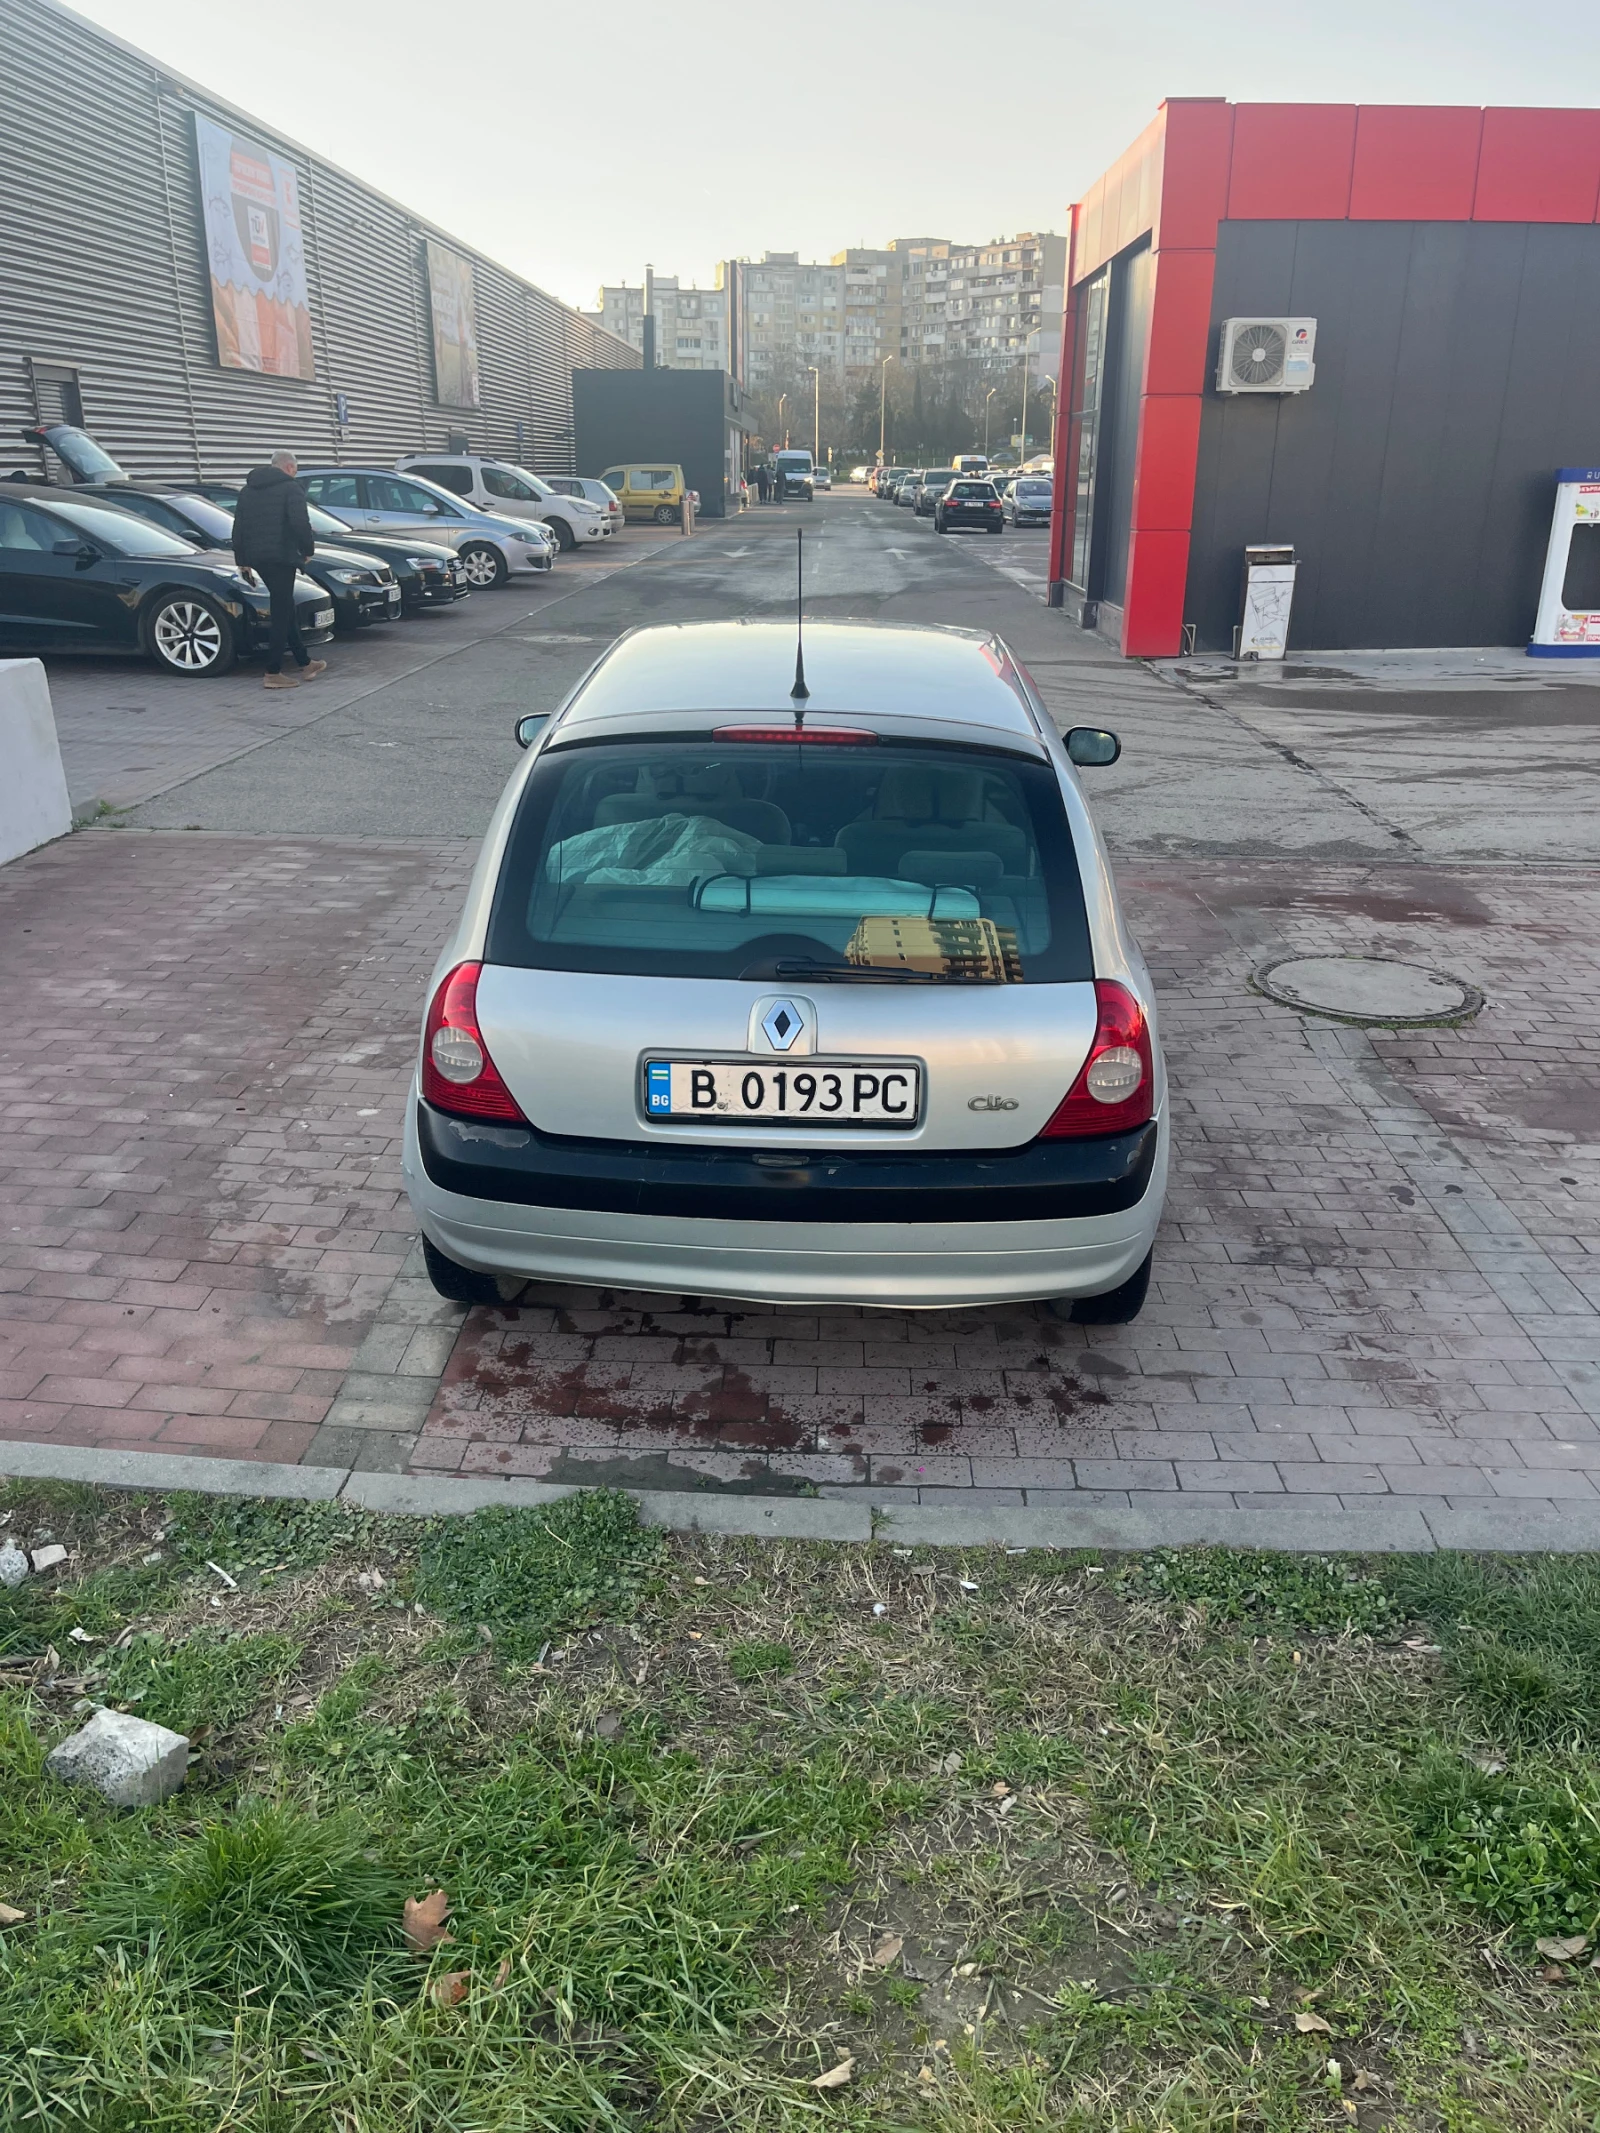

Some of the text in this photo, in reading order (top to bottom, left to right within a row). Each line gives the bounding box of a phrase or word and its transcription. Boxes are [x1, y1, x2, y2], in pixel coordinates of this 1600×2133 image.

[652, 1094, 669, 1106] BG
[691, 1070, 908, 1113] B 0193 PC
[967, 1093, 1020, 1111] Clio
